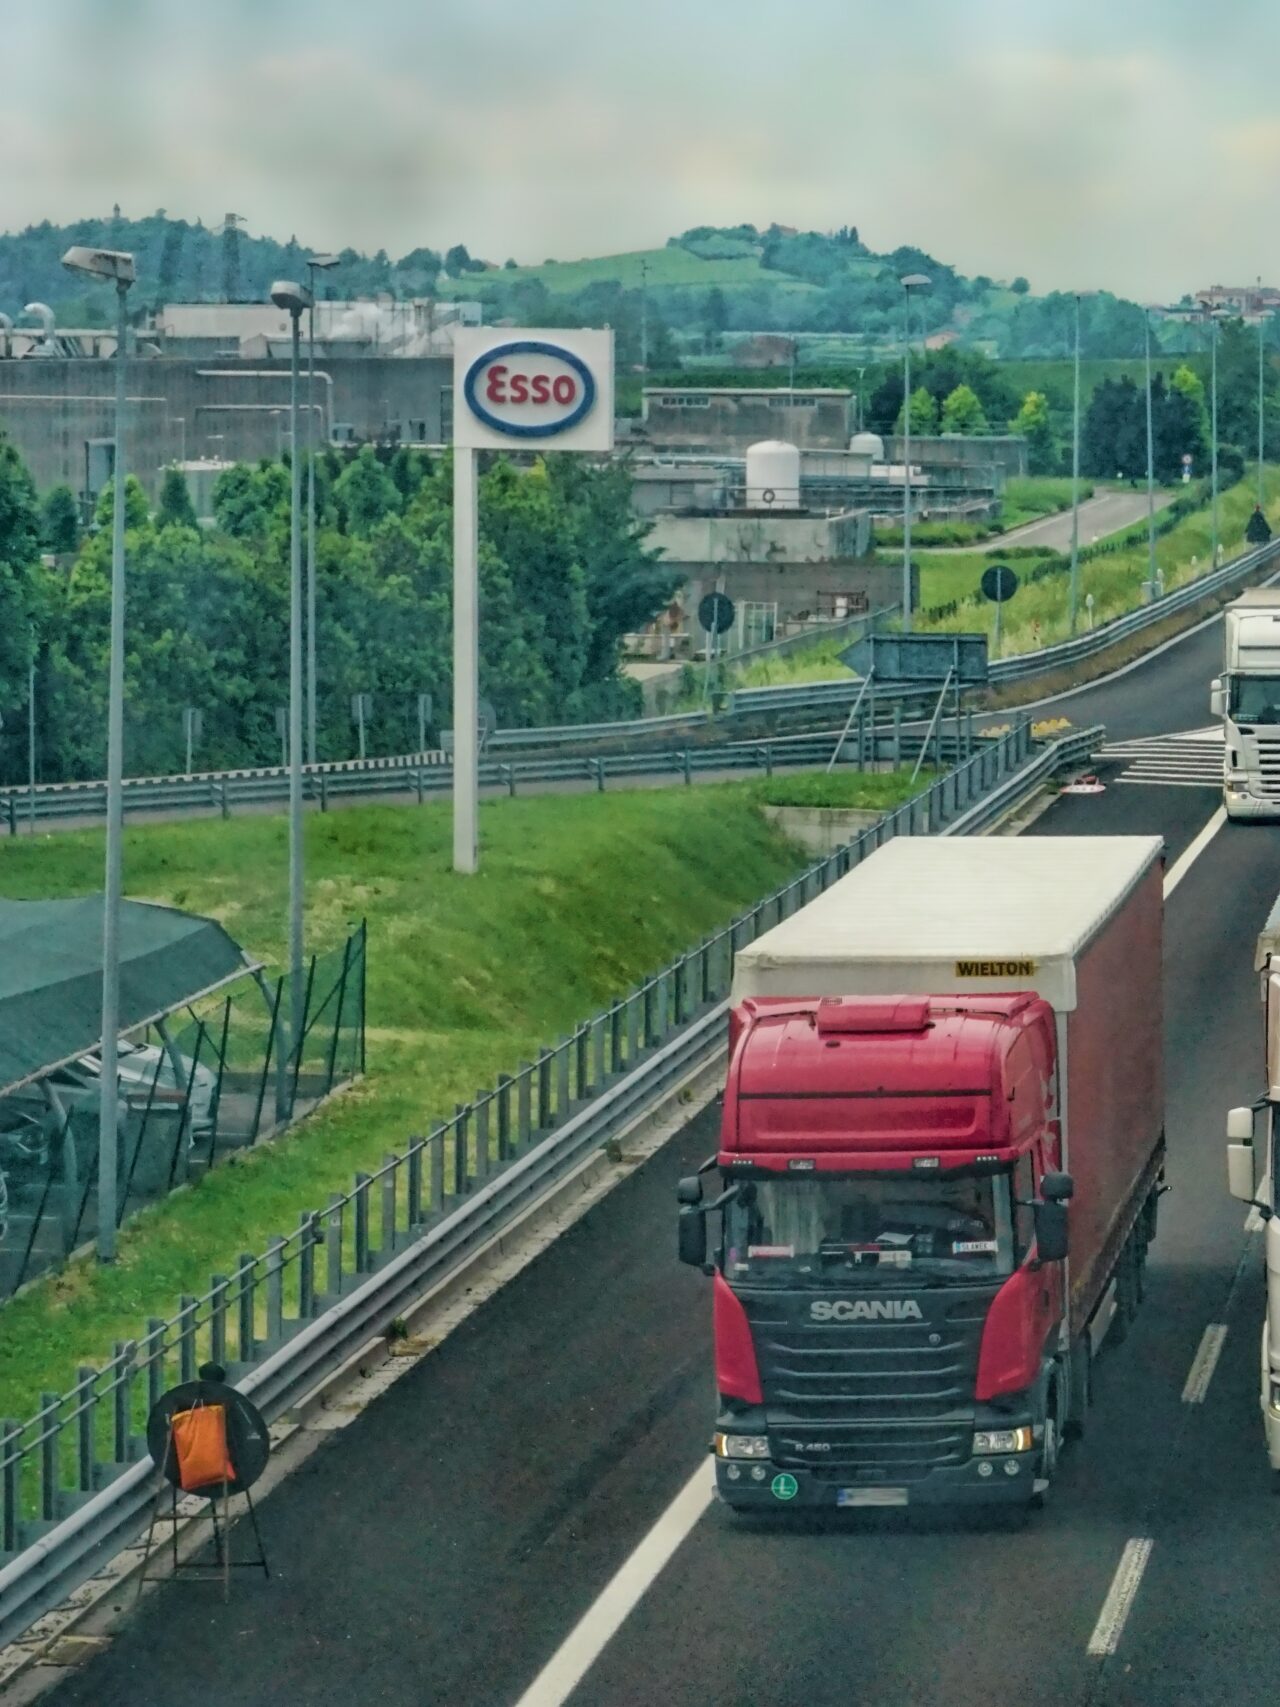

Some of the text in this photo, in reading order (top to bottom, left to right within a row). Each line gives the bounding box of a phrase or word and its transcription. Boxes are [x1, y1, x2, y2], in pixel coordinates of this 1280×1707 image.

[486, 364, 576, 405] Esso
[957, 961, 1031, 977] WIELTON
[810, 1300, 923, 1321] SCANIA
[778, 1477, 791, 1495] L
